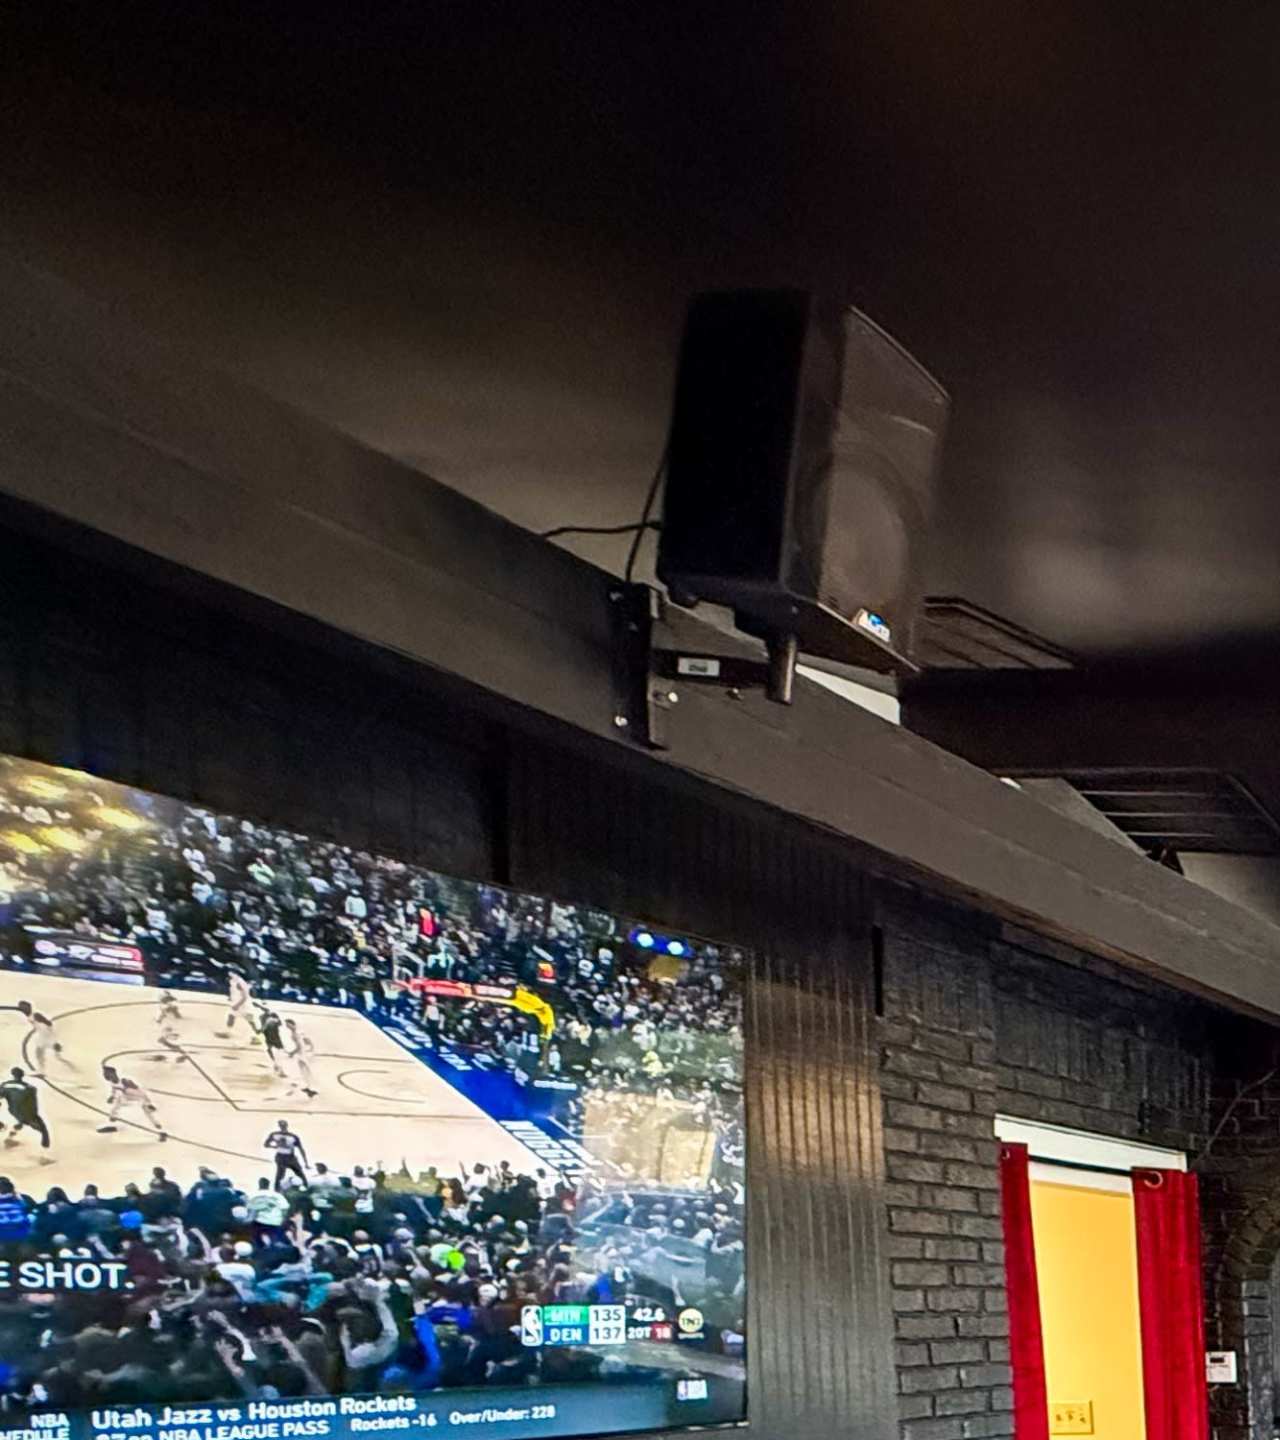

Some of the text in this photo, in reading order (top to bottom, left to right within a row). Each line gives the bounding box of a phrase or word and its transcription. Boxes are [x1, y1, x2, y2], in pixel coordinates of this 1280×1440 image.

[18, 1261, 135, 1289] SHOT.
[593, 1309, 622, 1321] 135
[550, 1328, 582, 1342] DEN
[593, 1327, 622, 1340] 137
[92, 1396, 416, 1429] Utah Jazz vs Houston Rockets
[30, 1413, 70, 1428] NBA
[351, 1417, 409, 1431] Rockets
[283, 1420, 330, 1437] PASS
